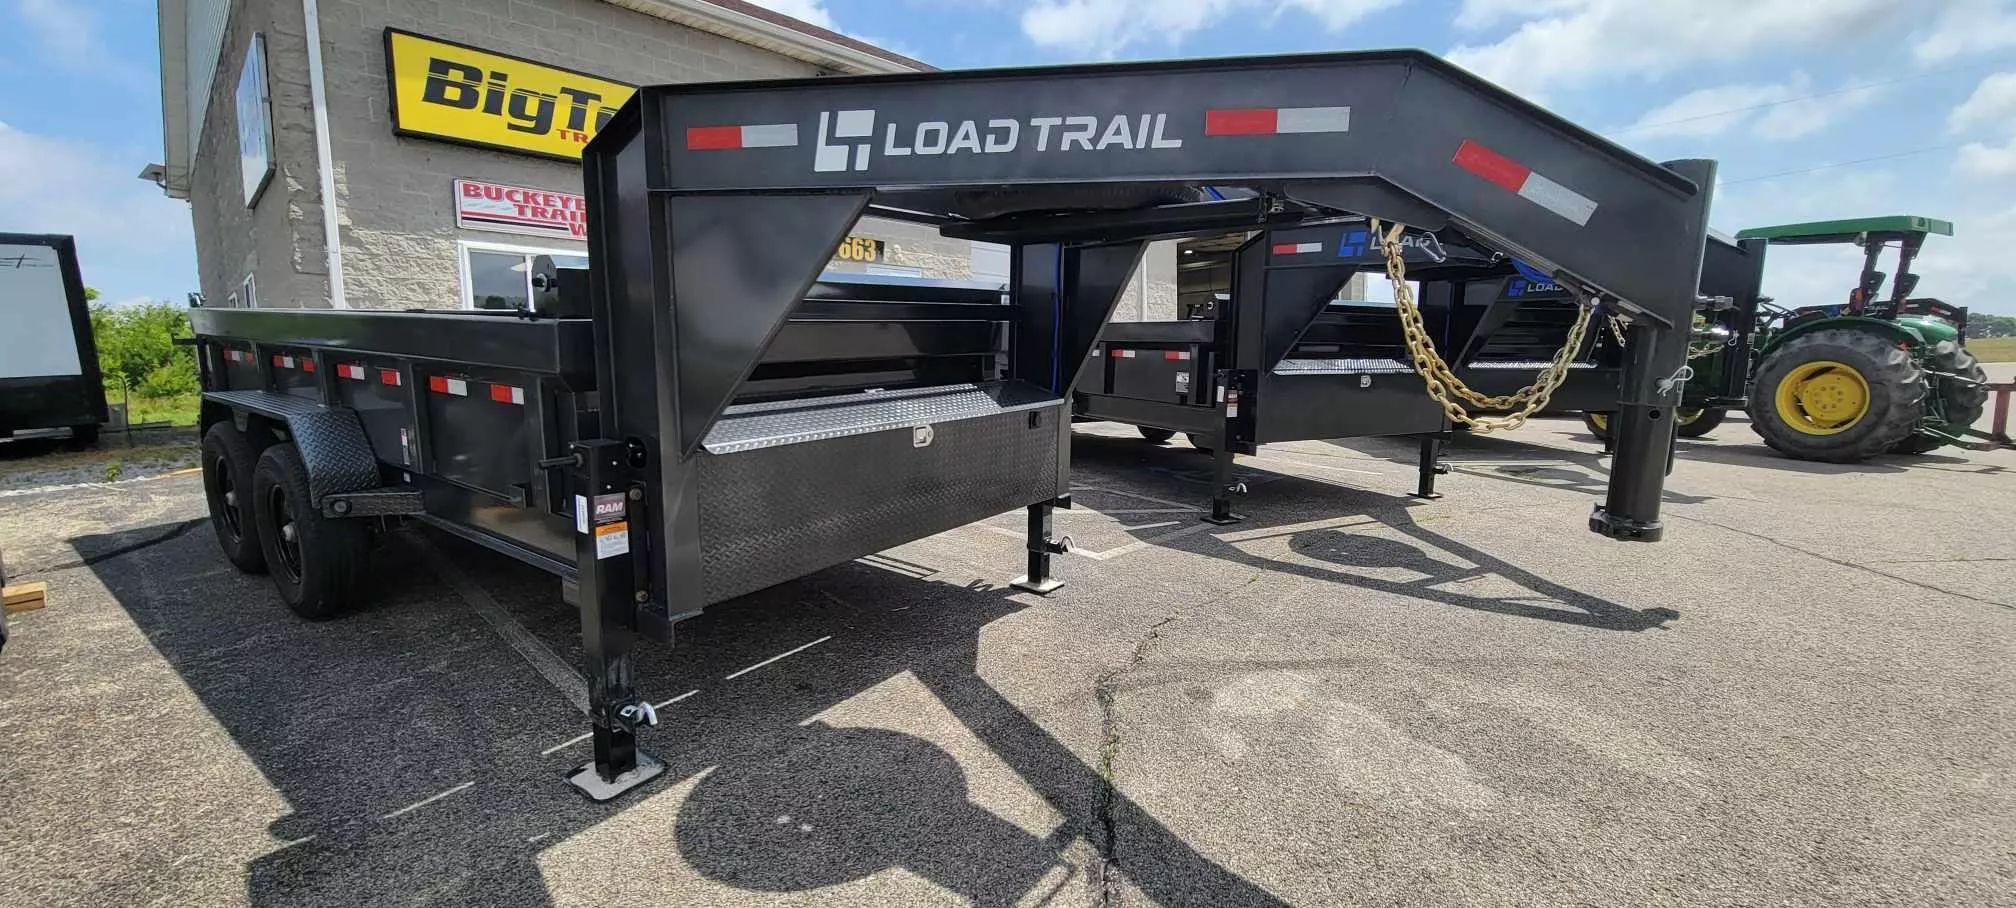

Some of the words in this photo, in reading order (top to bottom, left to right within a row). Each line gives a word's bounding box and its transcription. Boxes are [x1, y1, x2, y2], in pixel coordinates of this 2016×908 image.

[884, 118, 1020, 156] LOAD
[1030, 113, 1183, 151] TRAIL
[462, 183, 586, 211] BUCKEYE
[595, 501, 624, 515] RAM
